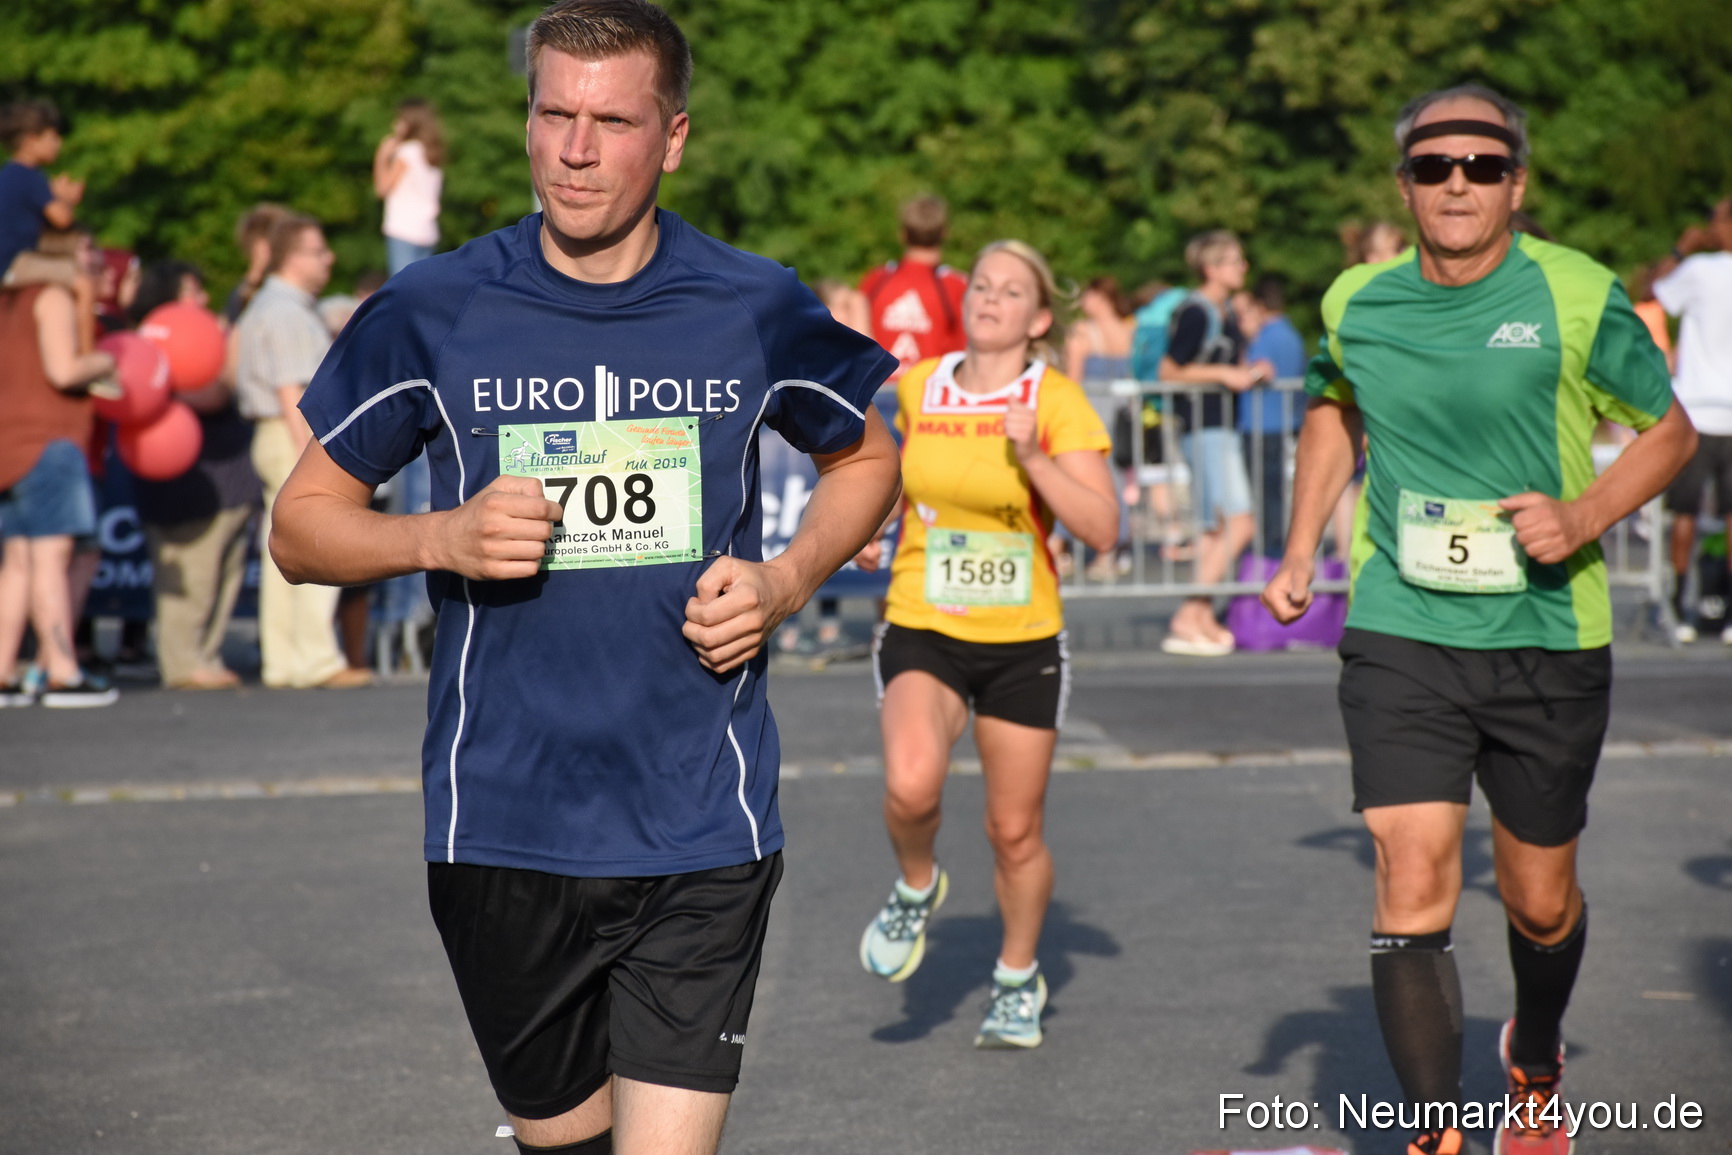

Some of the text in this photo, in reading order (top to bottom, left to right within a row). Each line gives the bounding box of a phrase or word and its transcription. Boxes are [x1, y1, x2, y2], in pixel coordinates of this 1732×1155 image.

[1487, 321, 1542, 343] AOK
[473, 377, 741, 413] EURO POLES
[917, 421, 967, 438] MAX
[530, 449, 607, 466] firmenlauf
[653, 457, 687, 469] 2019
[544, 473, 656, 528] 708
[611, 526, 664, 541] Manuel
[544, 540, 669, 557] uropoles GmbH & Co. KG
[1448, 534, 1469, 565] 5
[940, 558, 1016, 586] 1589
